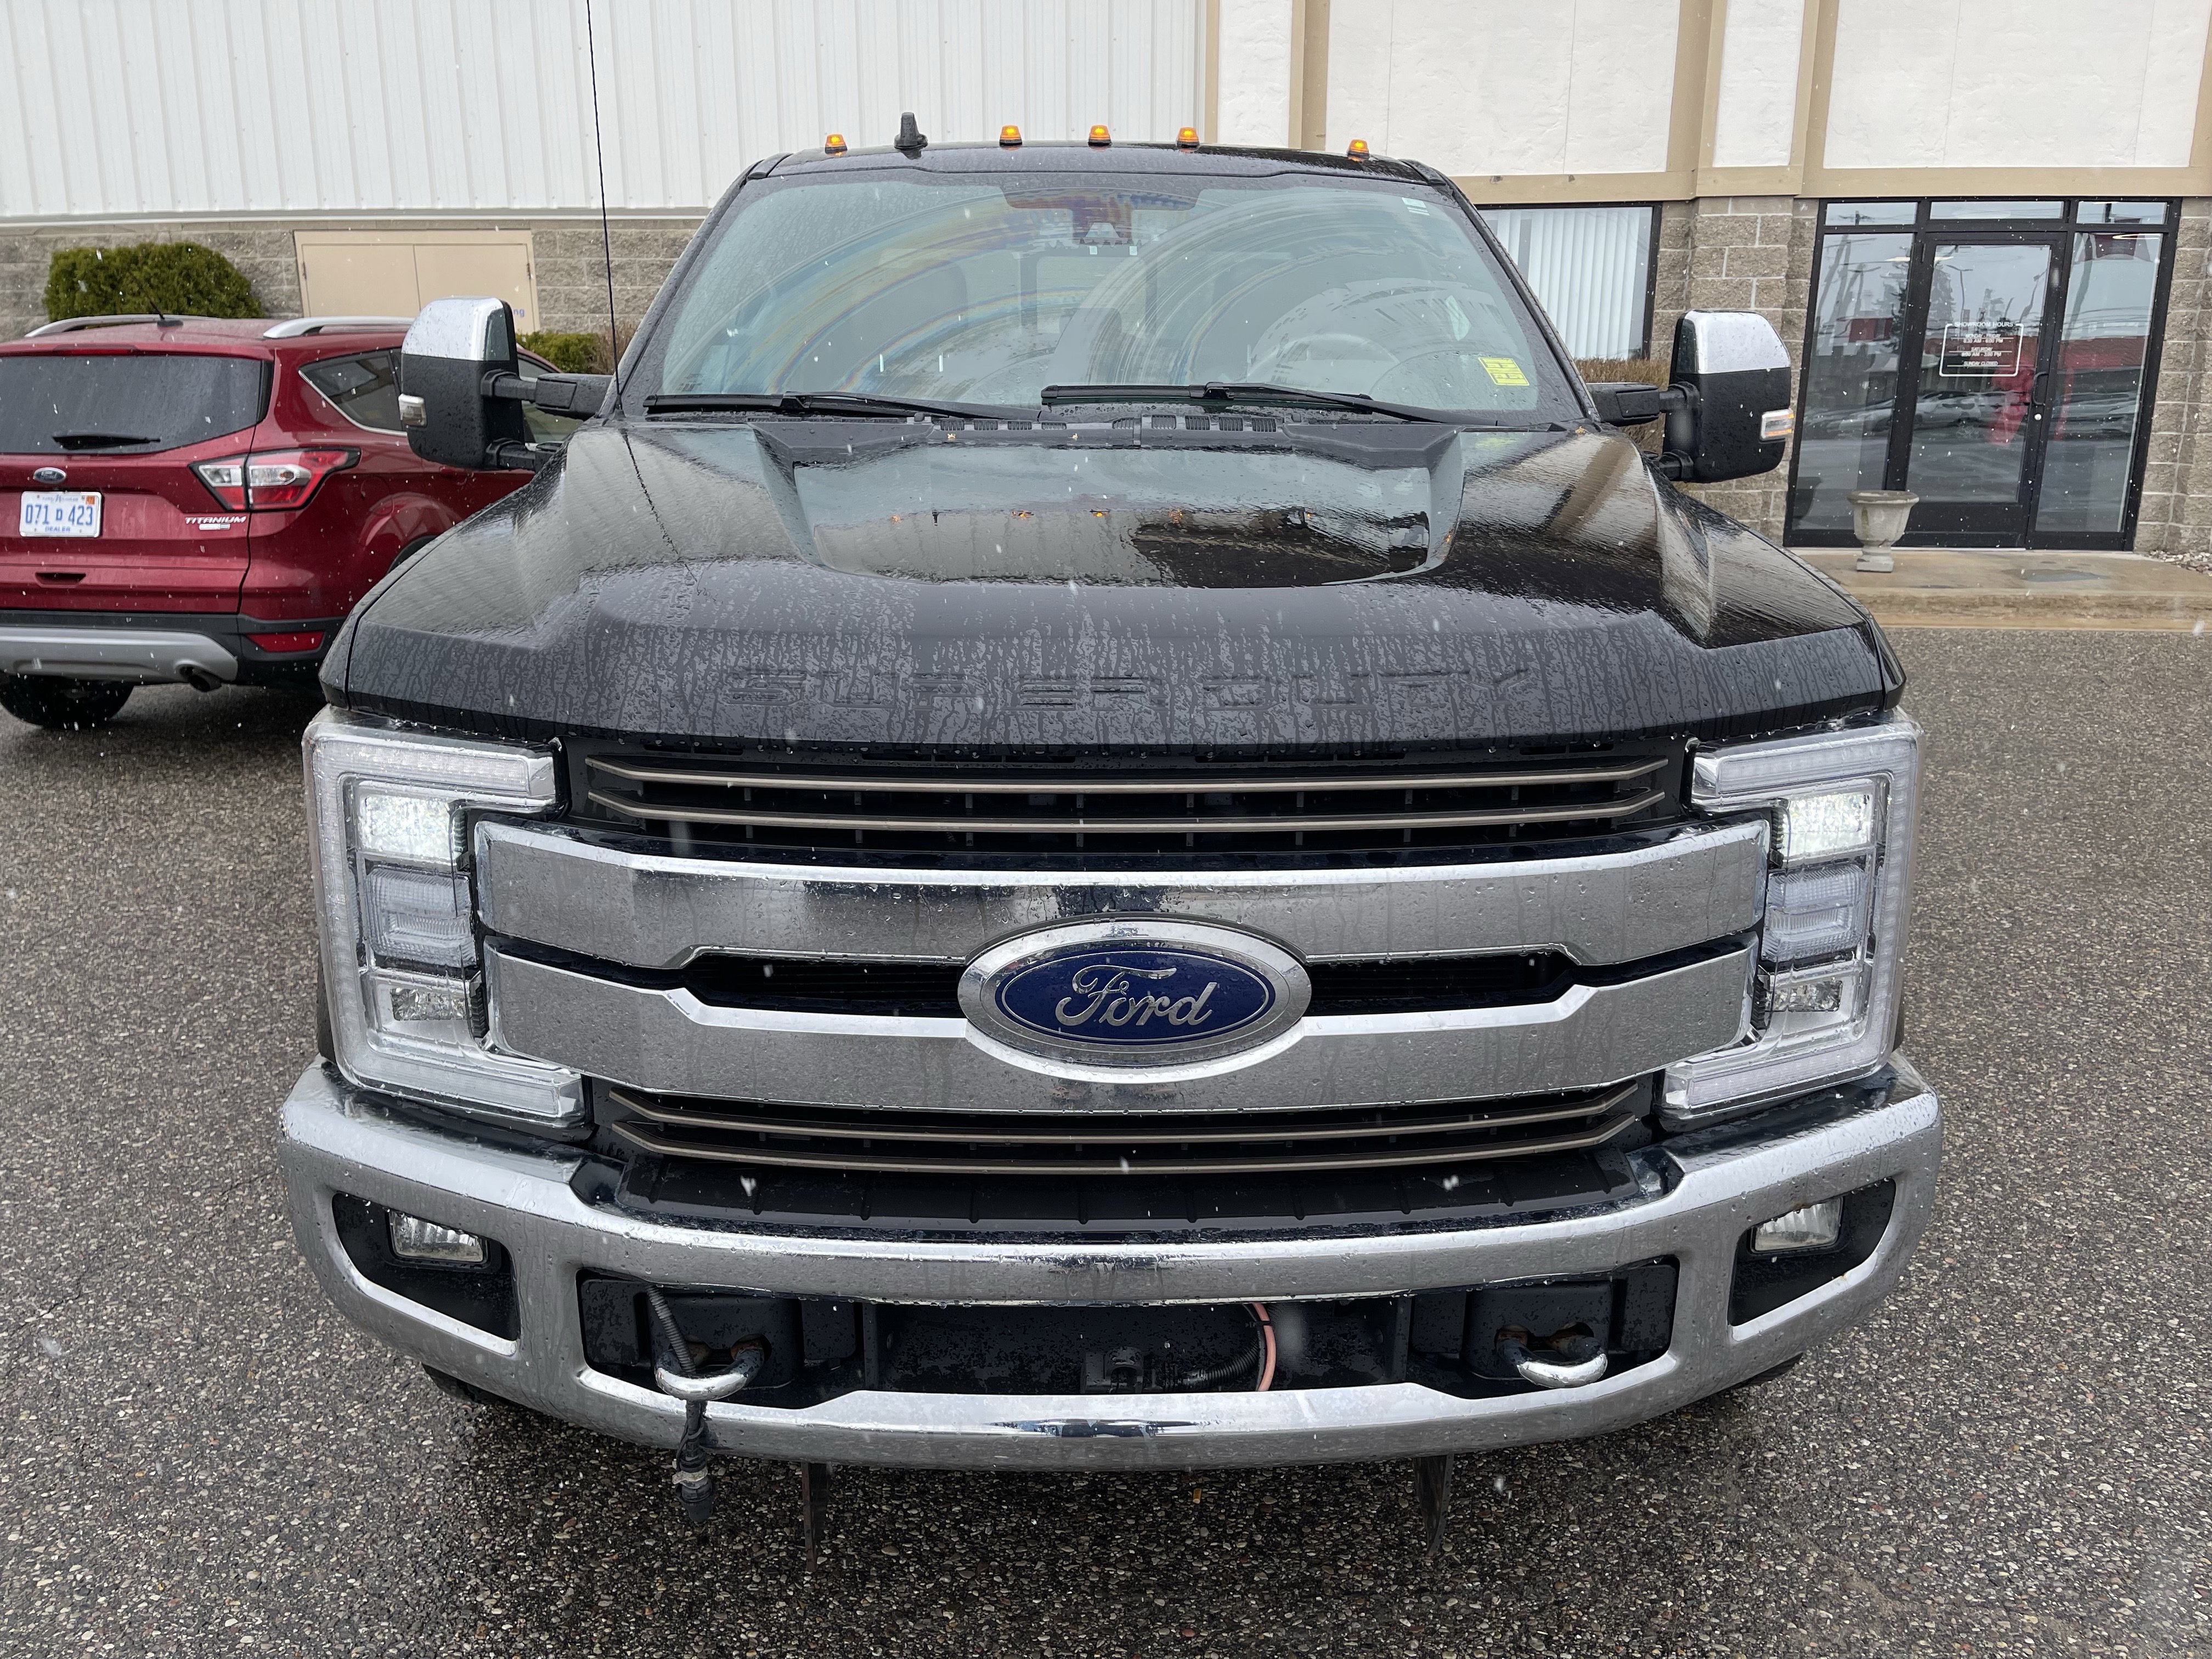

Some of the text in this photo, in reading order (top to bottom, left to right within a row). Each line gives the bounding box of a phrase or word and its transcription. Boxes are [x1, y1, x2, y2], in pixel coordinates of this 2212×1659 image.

[25, 504, 93, 526] 071 D 423
[185, 516, 246, 524] TITANIUM
[720, 667, 1530, 712] SUPER DUTY
[1055, 964, 1217, 1026] Ford
